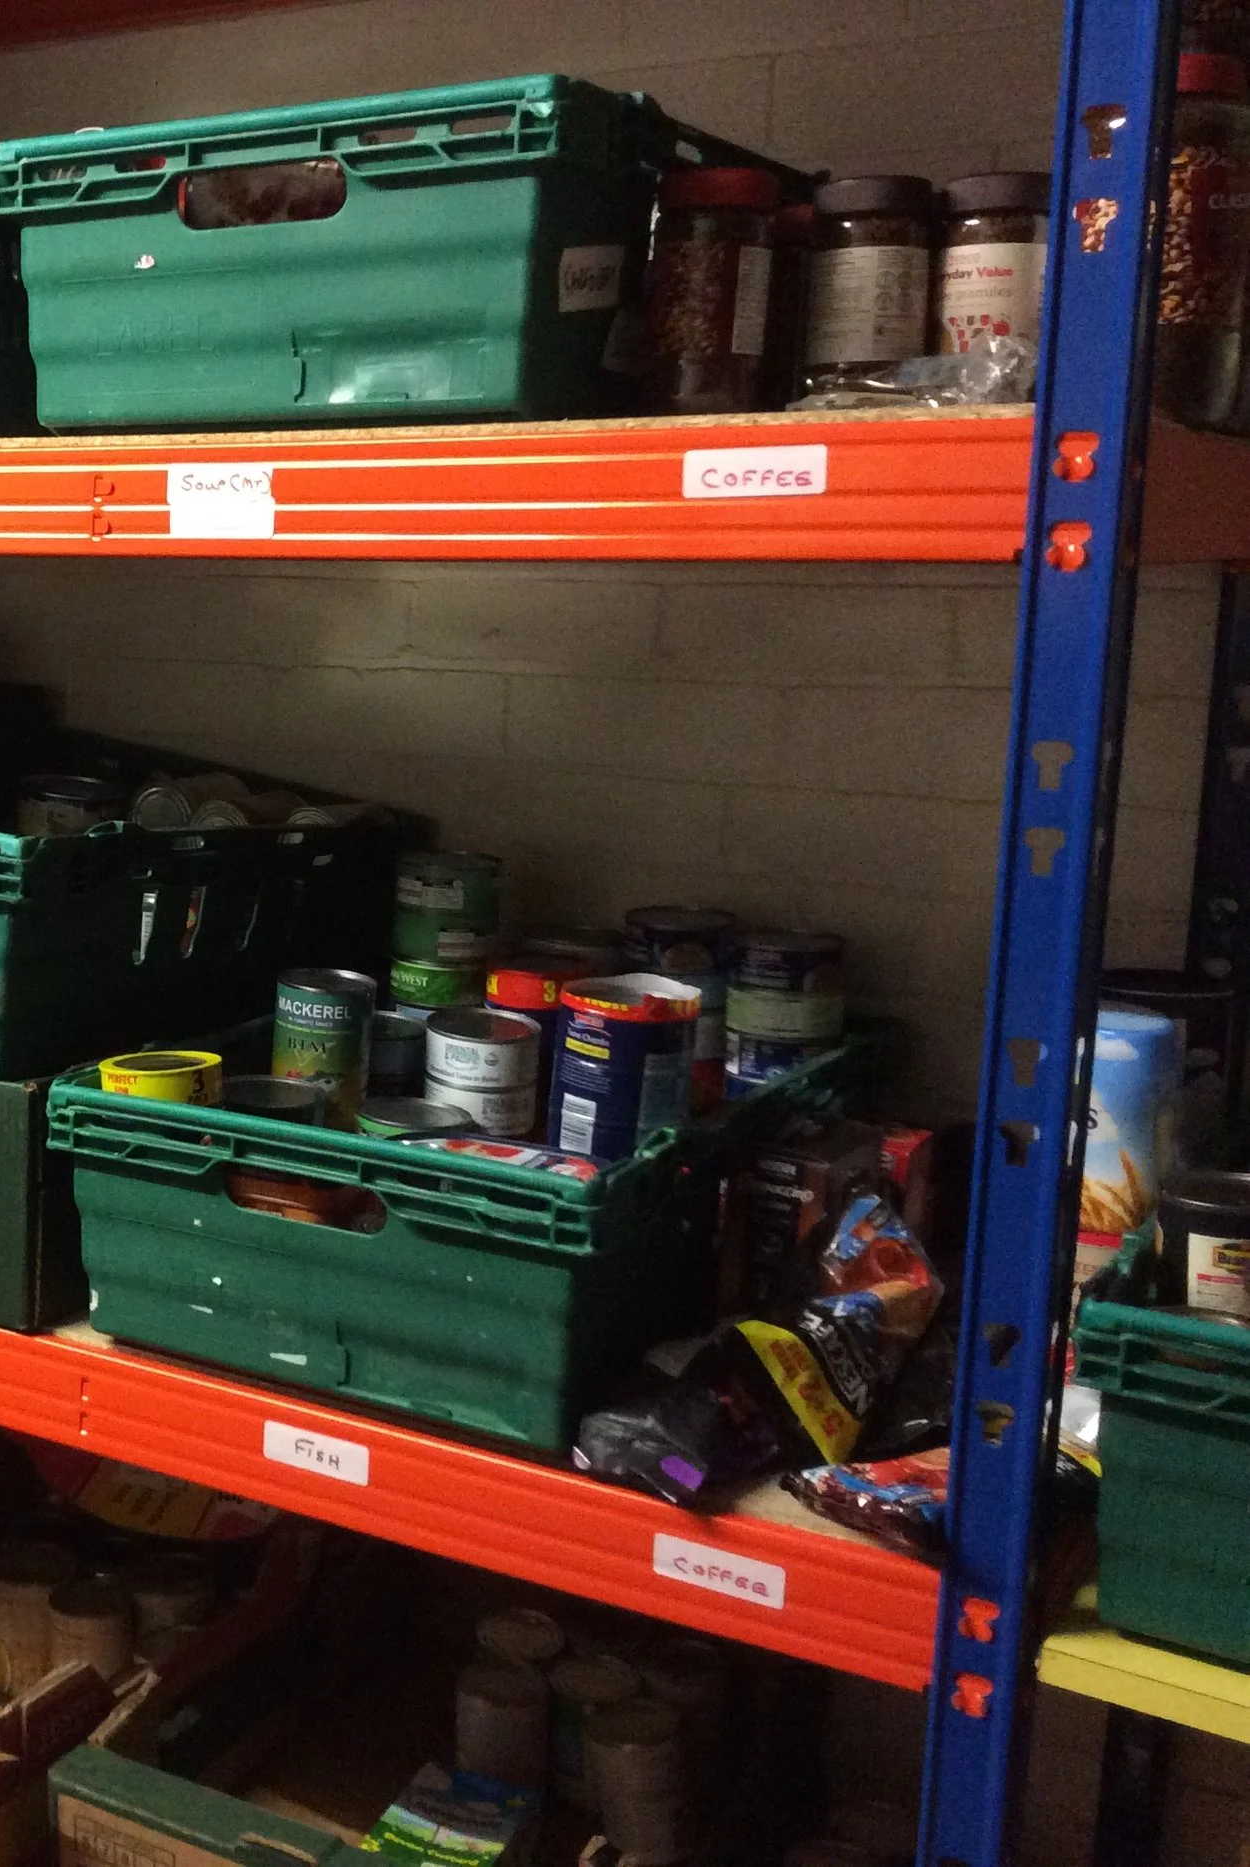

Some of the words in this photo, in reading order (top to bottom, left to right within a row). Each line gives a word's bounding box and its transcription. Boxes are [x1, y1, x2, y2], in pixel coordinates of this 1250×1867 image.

[701, 467, 813, 489] COFFEE
[401, 973, 430, 988] WEST
[278, 995, 352, 1020] MACKEREL
[192, 1070, 205, 1094] 3
[294, 1438, 340, 1471] FISH
